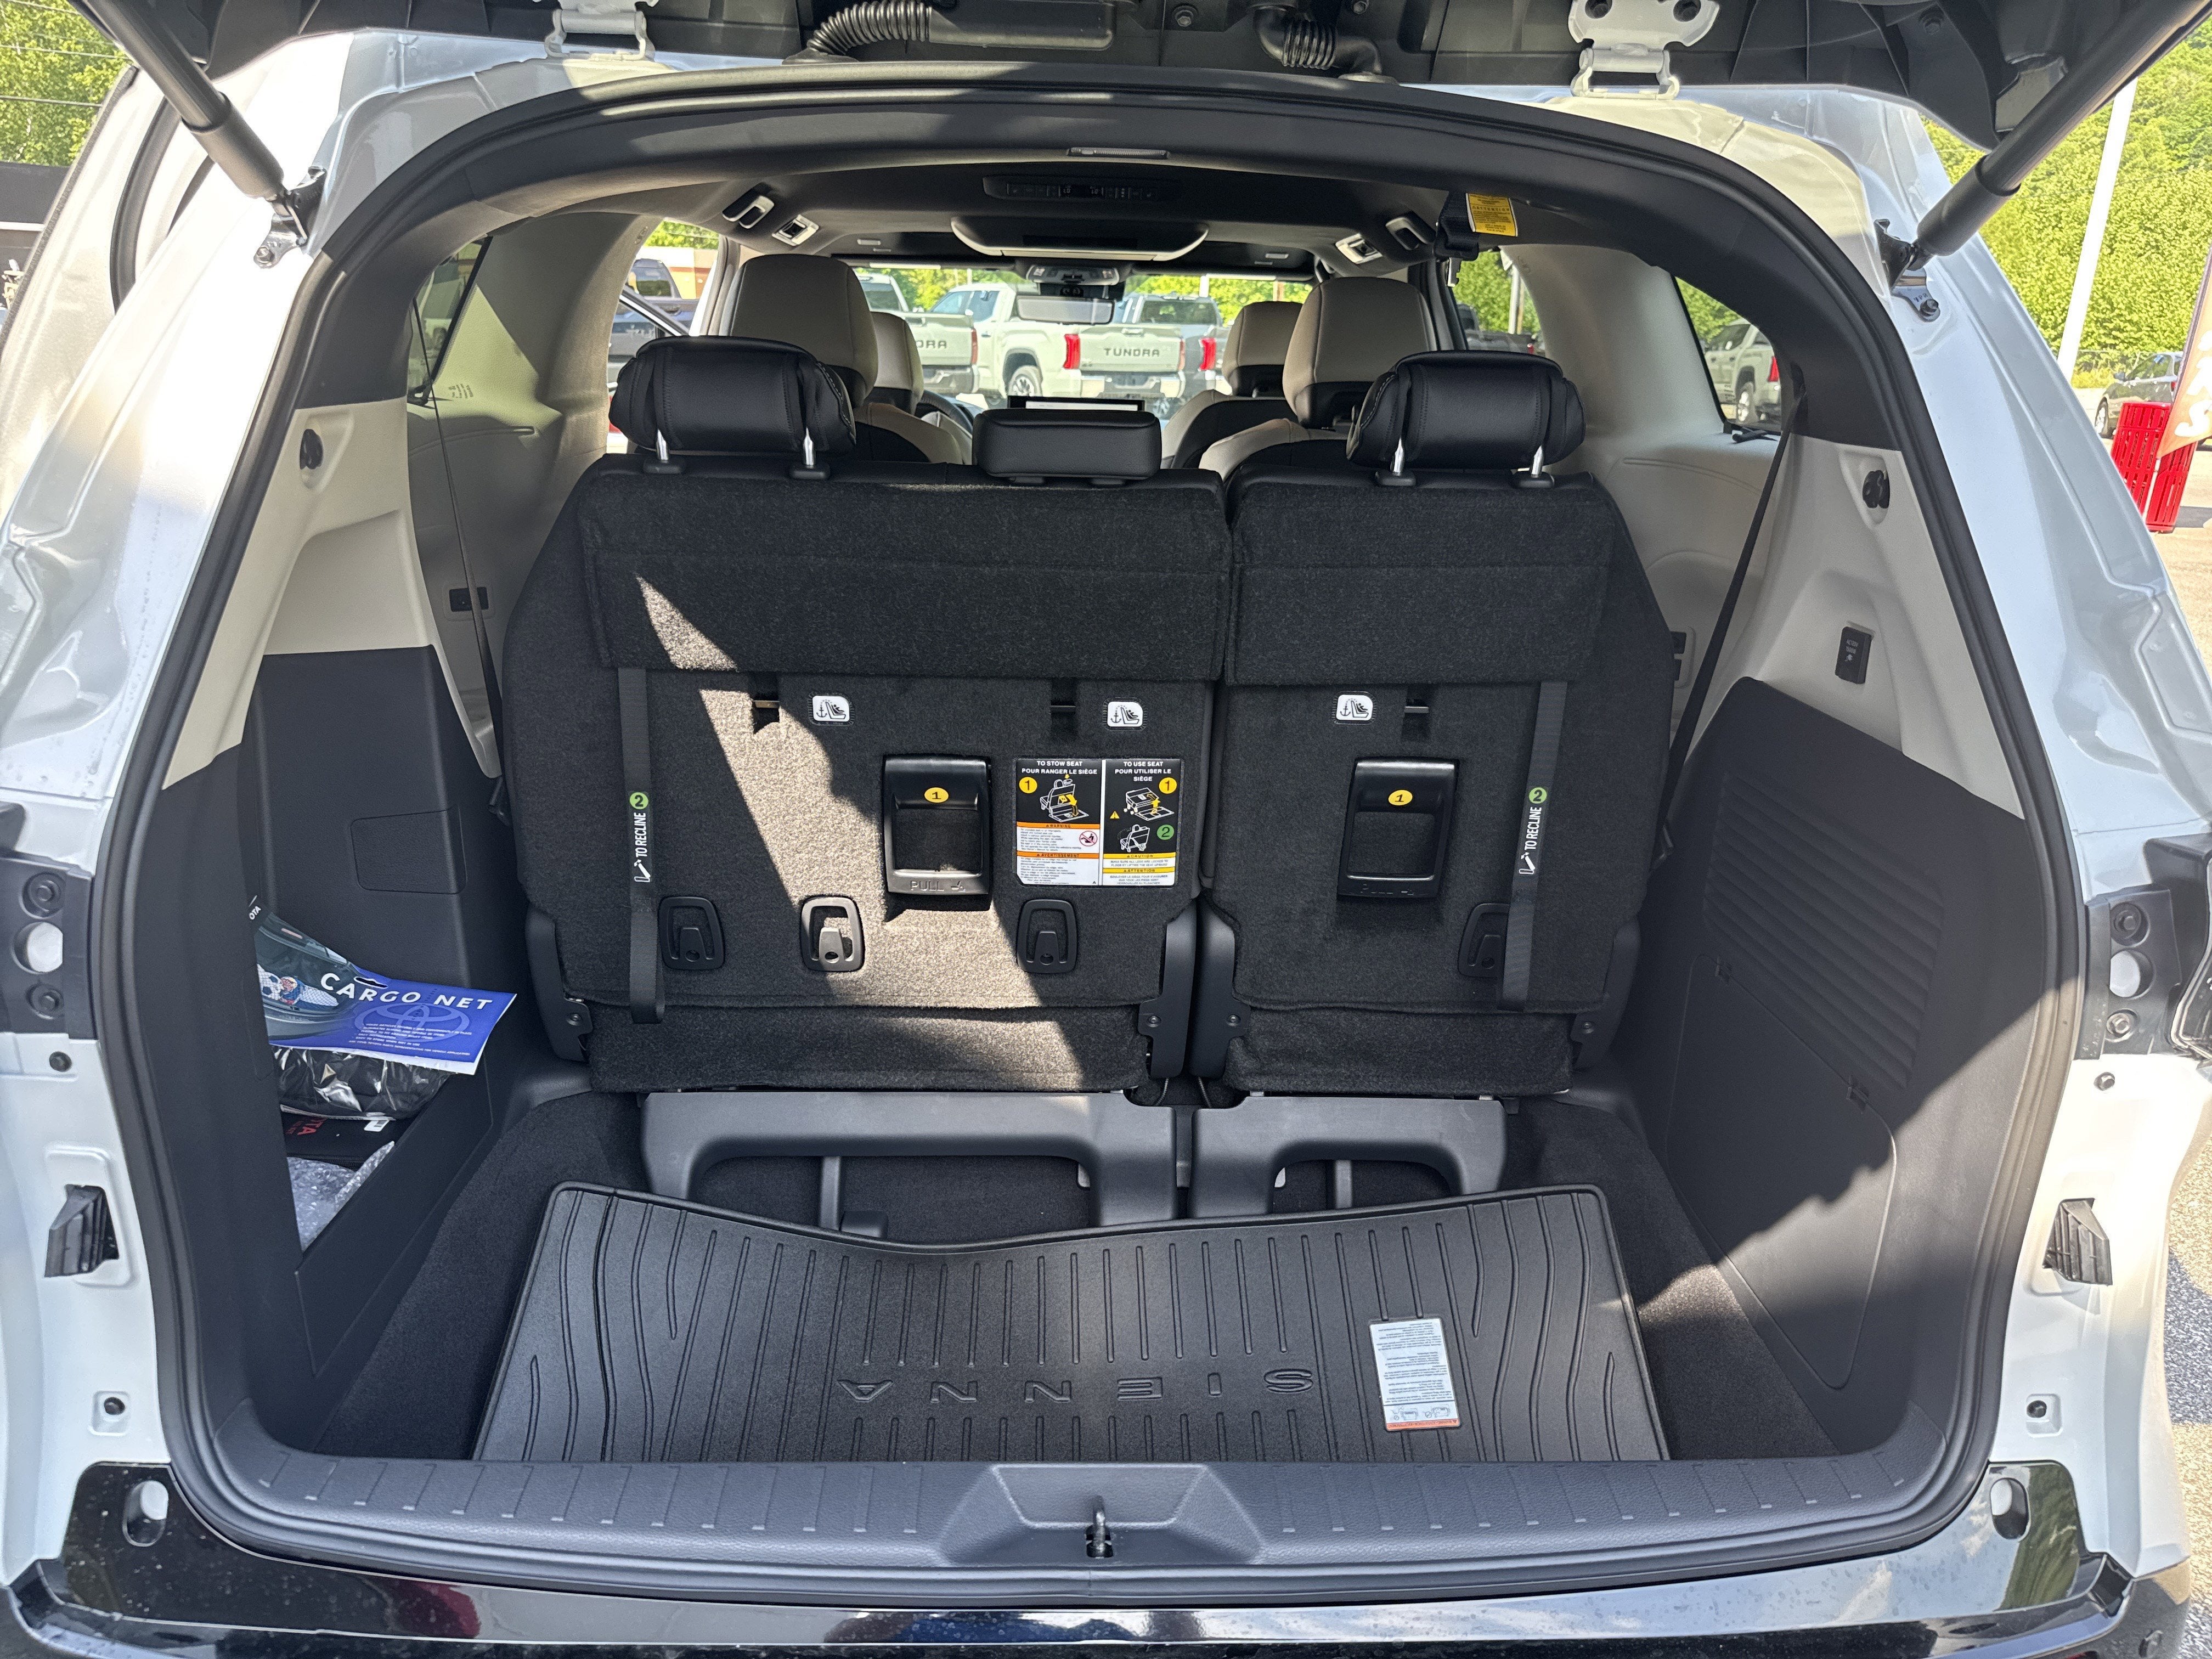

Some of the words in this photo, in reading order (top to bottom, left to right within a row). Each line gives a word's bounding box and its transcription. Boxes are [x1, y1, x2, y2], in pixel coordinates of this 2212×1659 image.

[1104, 348, 1160, 357] TUNDRA
[635, 795, 644, 807] 2
[1533, 789, 1543, 802] 2
[1526, 806, 1542, 839] RECLINE
[634, 812, 647, 846] RECLINE
[1525, 840, 1537, 850] TO
[635, 848, 647, 857] TO
[910, 880, 945, 891] PULL
[321, 973, 421, 1003] CARGO
[434, 995, 493, 1010] NET
[837, 1368, 1313, 1403] SIENNA
